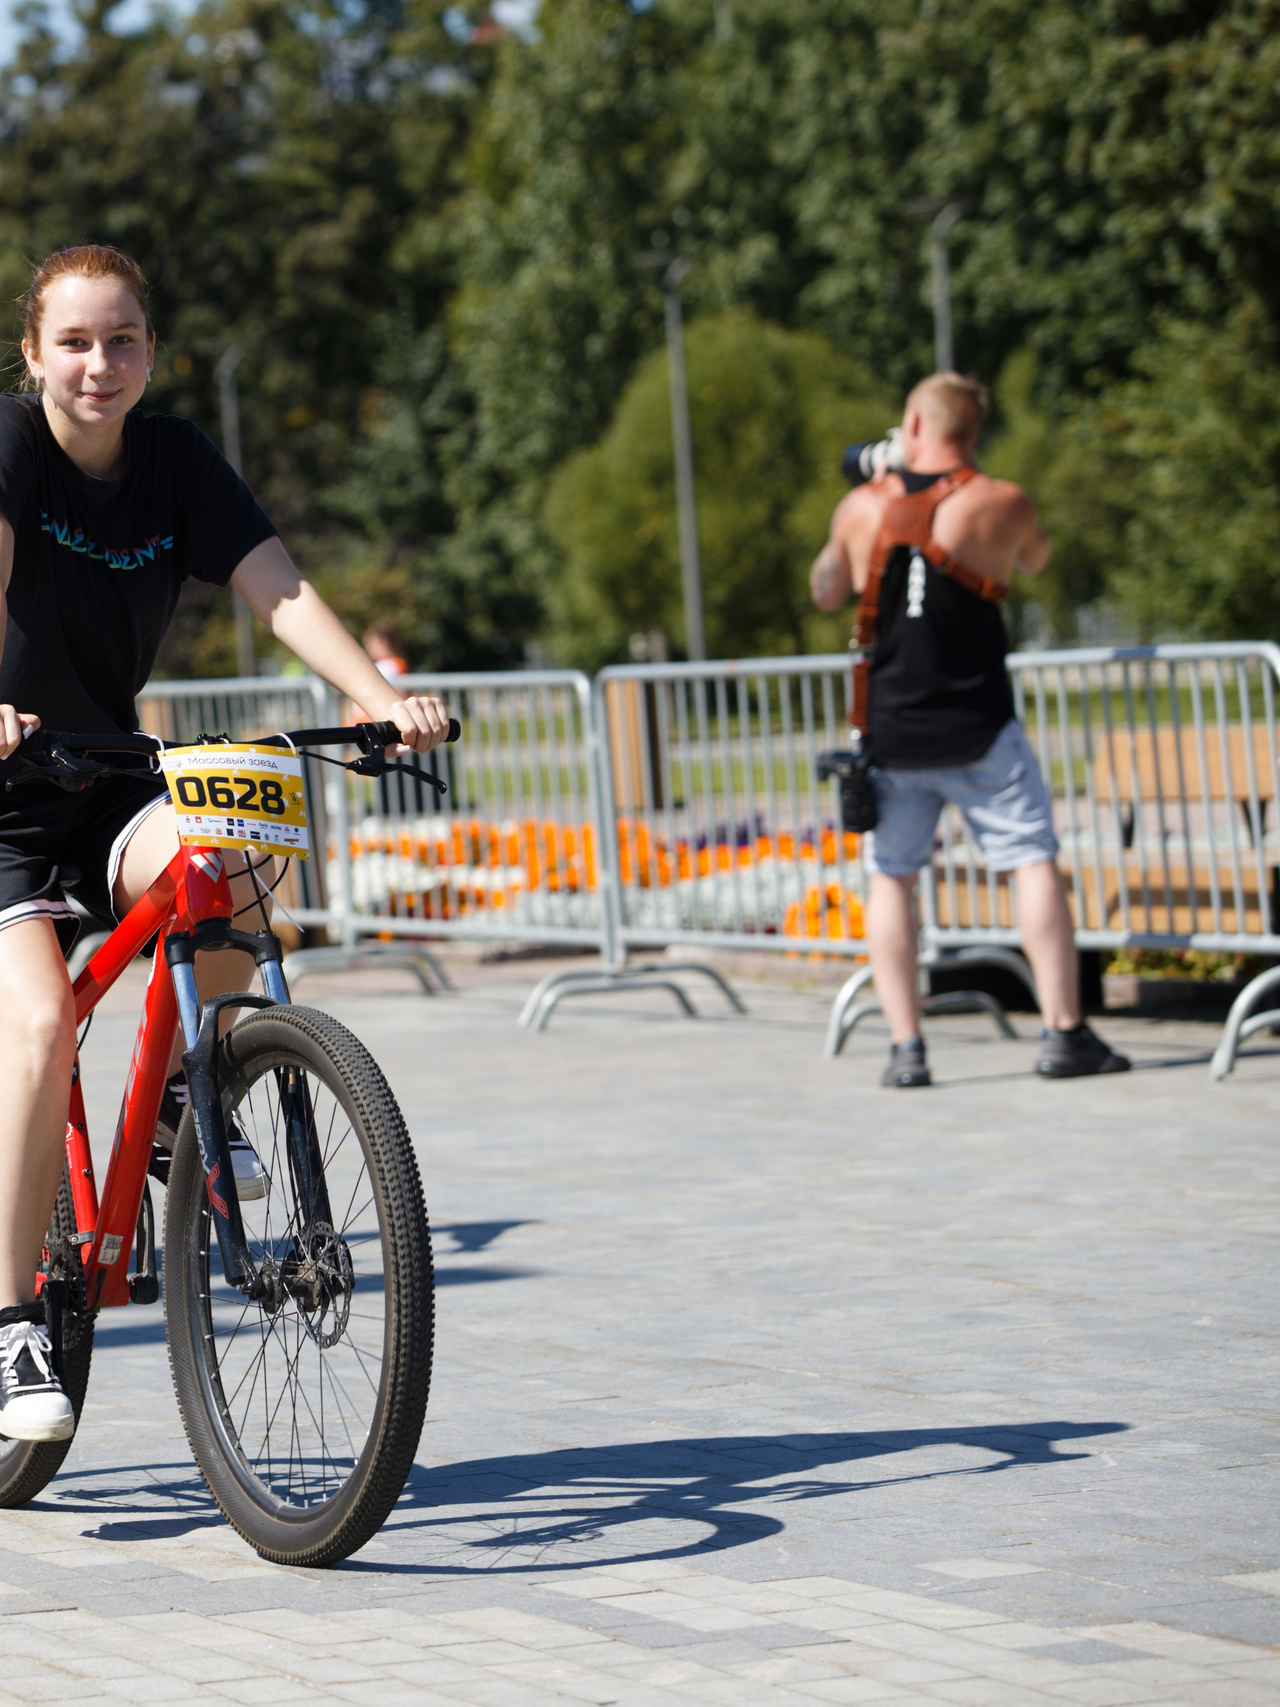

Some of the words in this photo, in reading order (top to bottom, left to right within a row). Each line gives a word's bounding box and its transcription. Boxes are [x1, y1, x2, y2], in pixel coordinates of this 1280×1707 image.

[188, 757, 246, 765] Массовый
[248, 758, 278, 770] заезд
[176, 776, 285, 815] 0628
